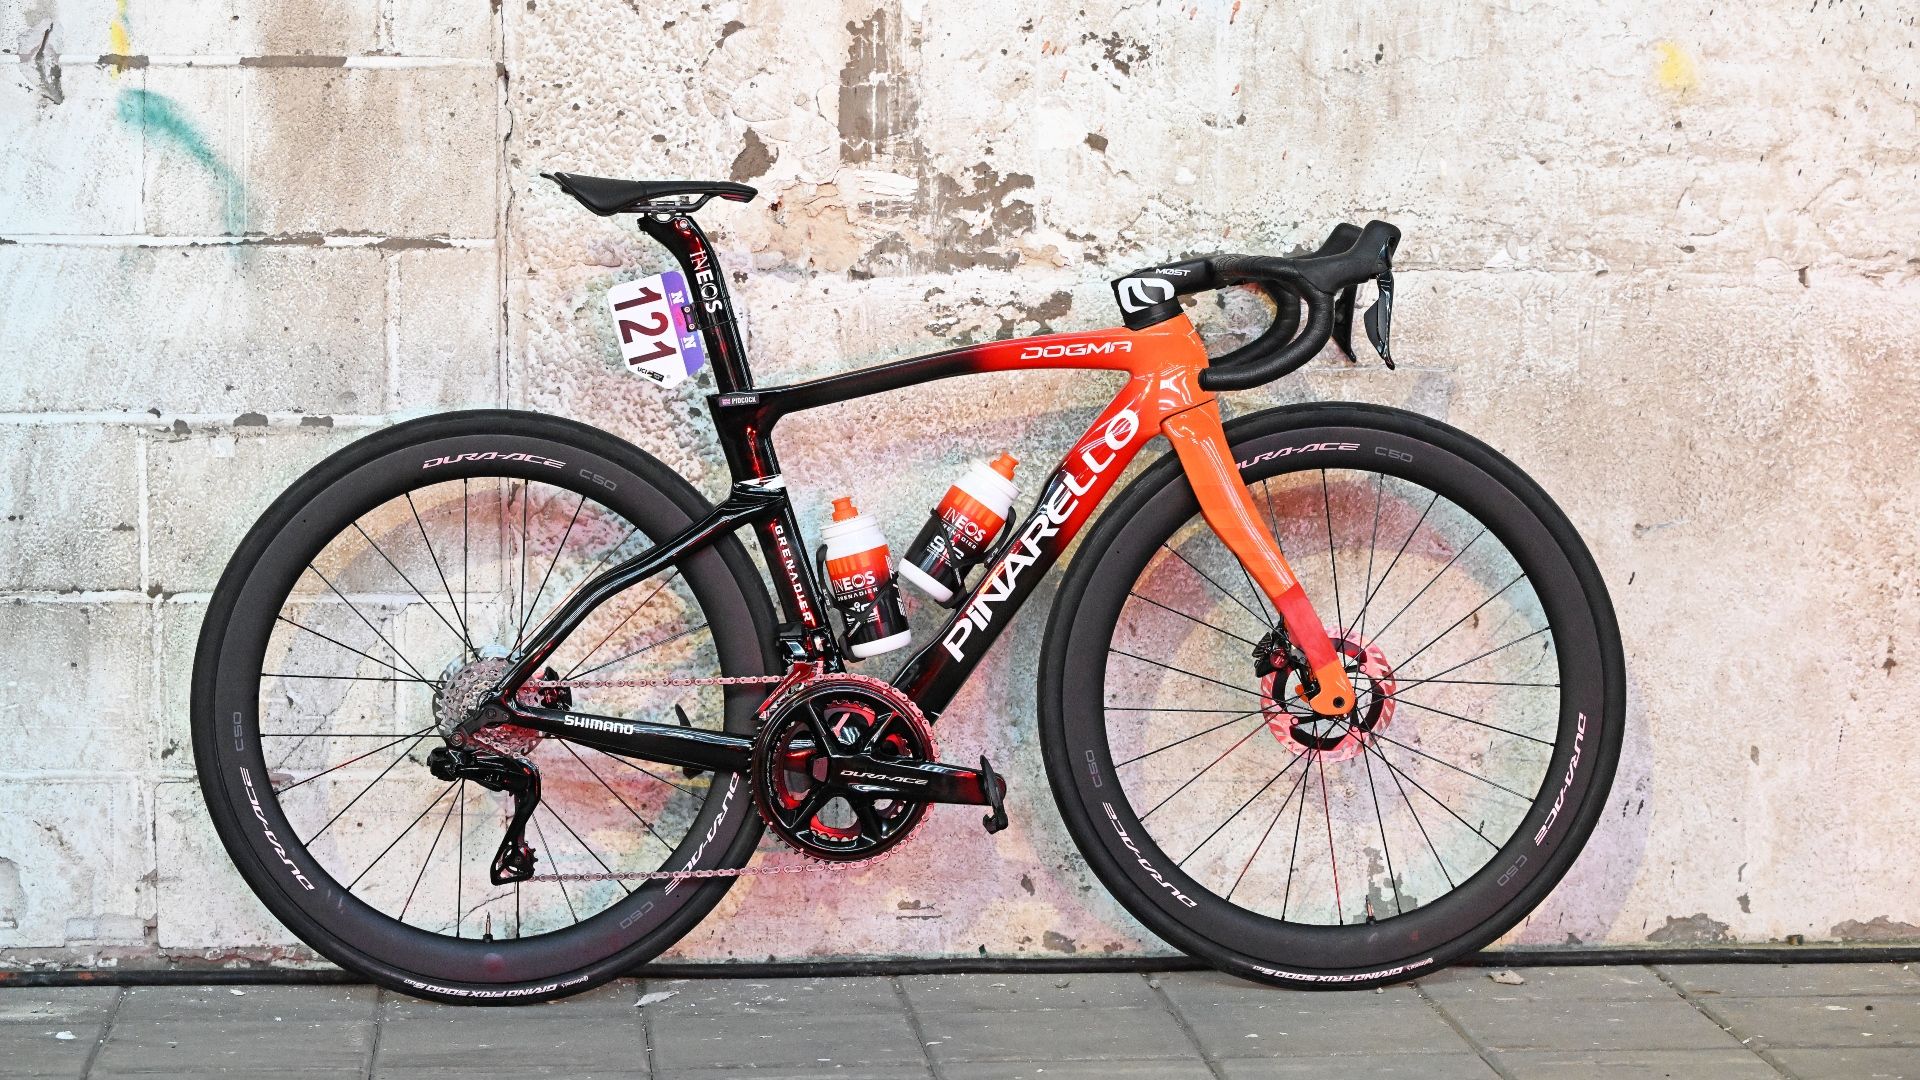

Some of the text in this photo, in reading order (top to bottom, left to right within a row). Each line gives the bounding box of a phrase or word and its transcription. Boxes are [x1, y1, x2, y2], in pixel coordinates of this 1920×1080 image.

[689, 250, 723, 313] INEOS
[614, 286, 677, 366] 121
[1020, 340, 1133, 360] DOGMA
[731, 396, 757, 405] PIDCOCK
[1374, 446, 1414, 463] C50
[422, 451, 617, 492] DURA-ACE C50
[941, 521, 977, 550] RENADIER
[942, 408, 1140, 663] PINARELLO
[943, 506, 987, 542] INEOS
[774, 524, 812, 623] GRENADIER
[832, 570, 876, 594] INEOS
[564, 715, 634, 735] SHIMANO
[840, 769, 930, 786] DURA-ACE
[232, 711, 315, 890] DURA-ACE C50
[1497, 712, 1587, 887] DURA-ACE C50
[1085, 750, 1198, 908] DURA-ACE C50
[619, 901, 654, 929] C50
[1273, 970, 1318, 982] 5000
[1317, 974, 1354, 983] PRIX
[1353, 966, 1404, 982] GRAND
[425, 984, 470, 997] 5000
[469, 990, 508, 998] PRIX
[506, 983, 558, 997] GRAND
